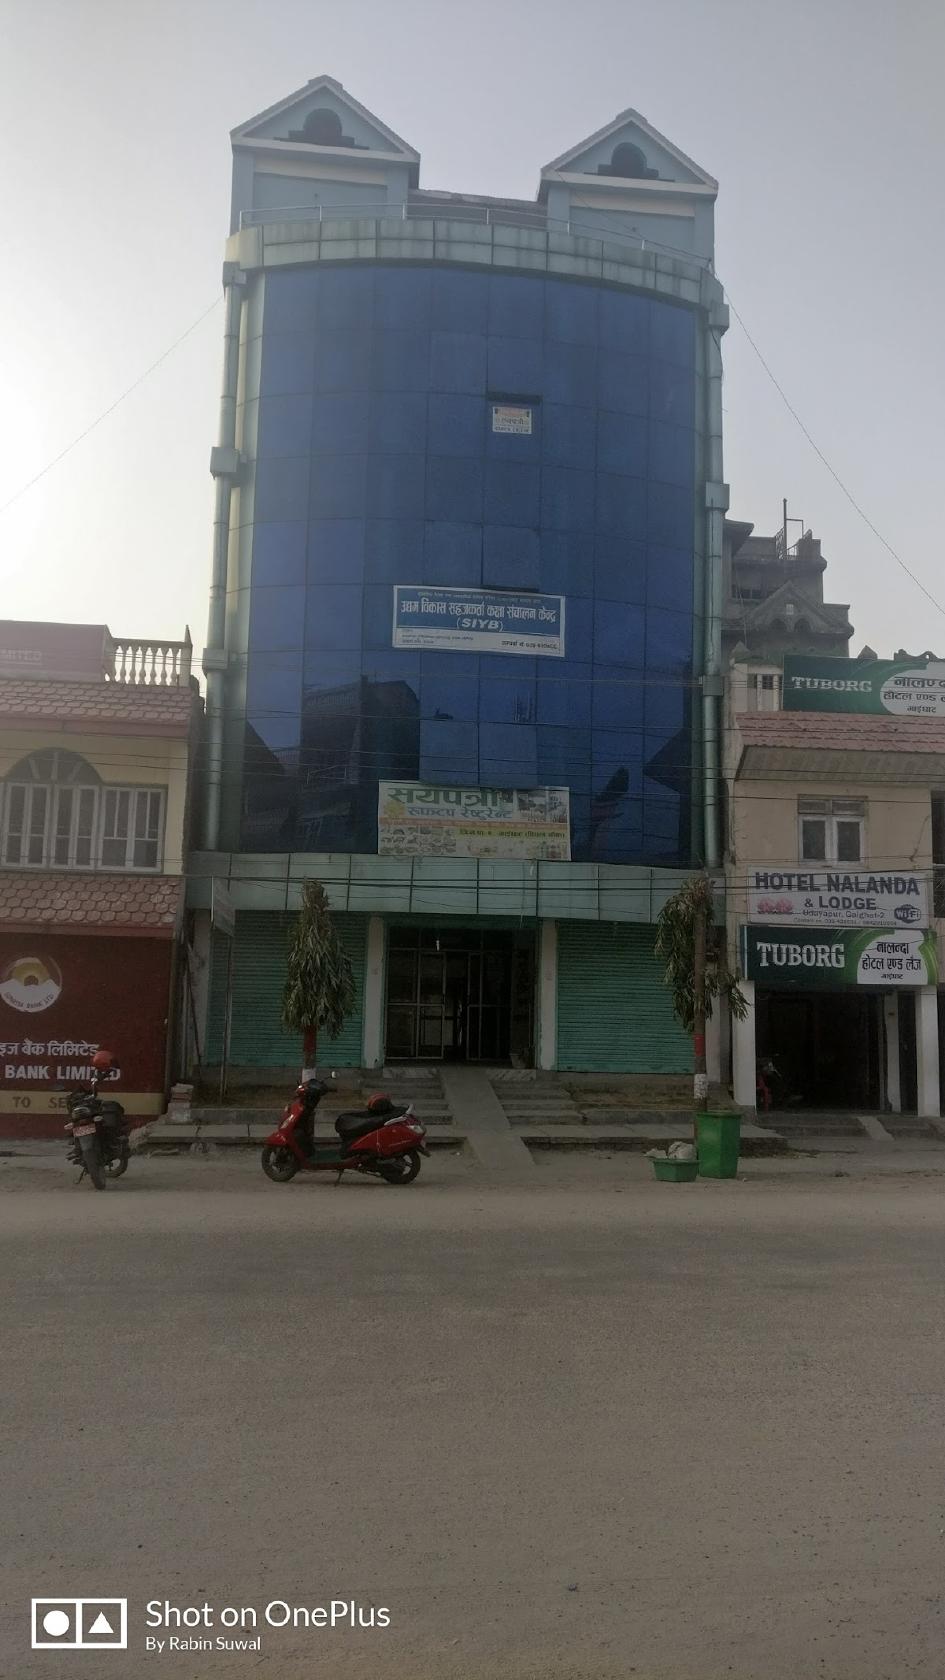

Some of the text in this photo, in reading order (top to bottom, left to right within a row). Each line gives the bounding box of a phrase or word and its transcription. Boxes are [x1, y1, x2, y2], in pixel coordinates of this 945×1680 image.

[421, 597, 447, 614] विकास
[507, 604, 536, 620] संचालन
[456, 617, 504, 632] (SIYB)
[791, 676, 872, 692] TUBORG
[884, 690, 912, 700] होटल
[916, 693, 937, 702] एण्ड
[755, 872, 920, 895] HOTEL NALANDA
[804, 895, 877, 910] & LODGE
[756, 941, 845, 969] TUBORG
[876, 942, 910, 954] नालन्दा
[861, 954, 884, 970] होटल
[887, 958, 903, 970] एण्ड
[5, 1065, 50, 1079] BANK
[12, 1096, 31, 1109] TO
